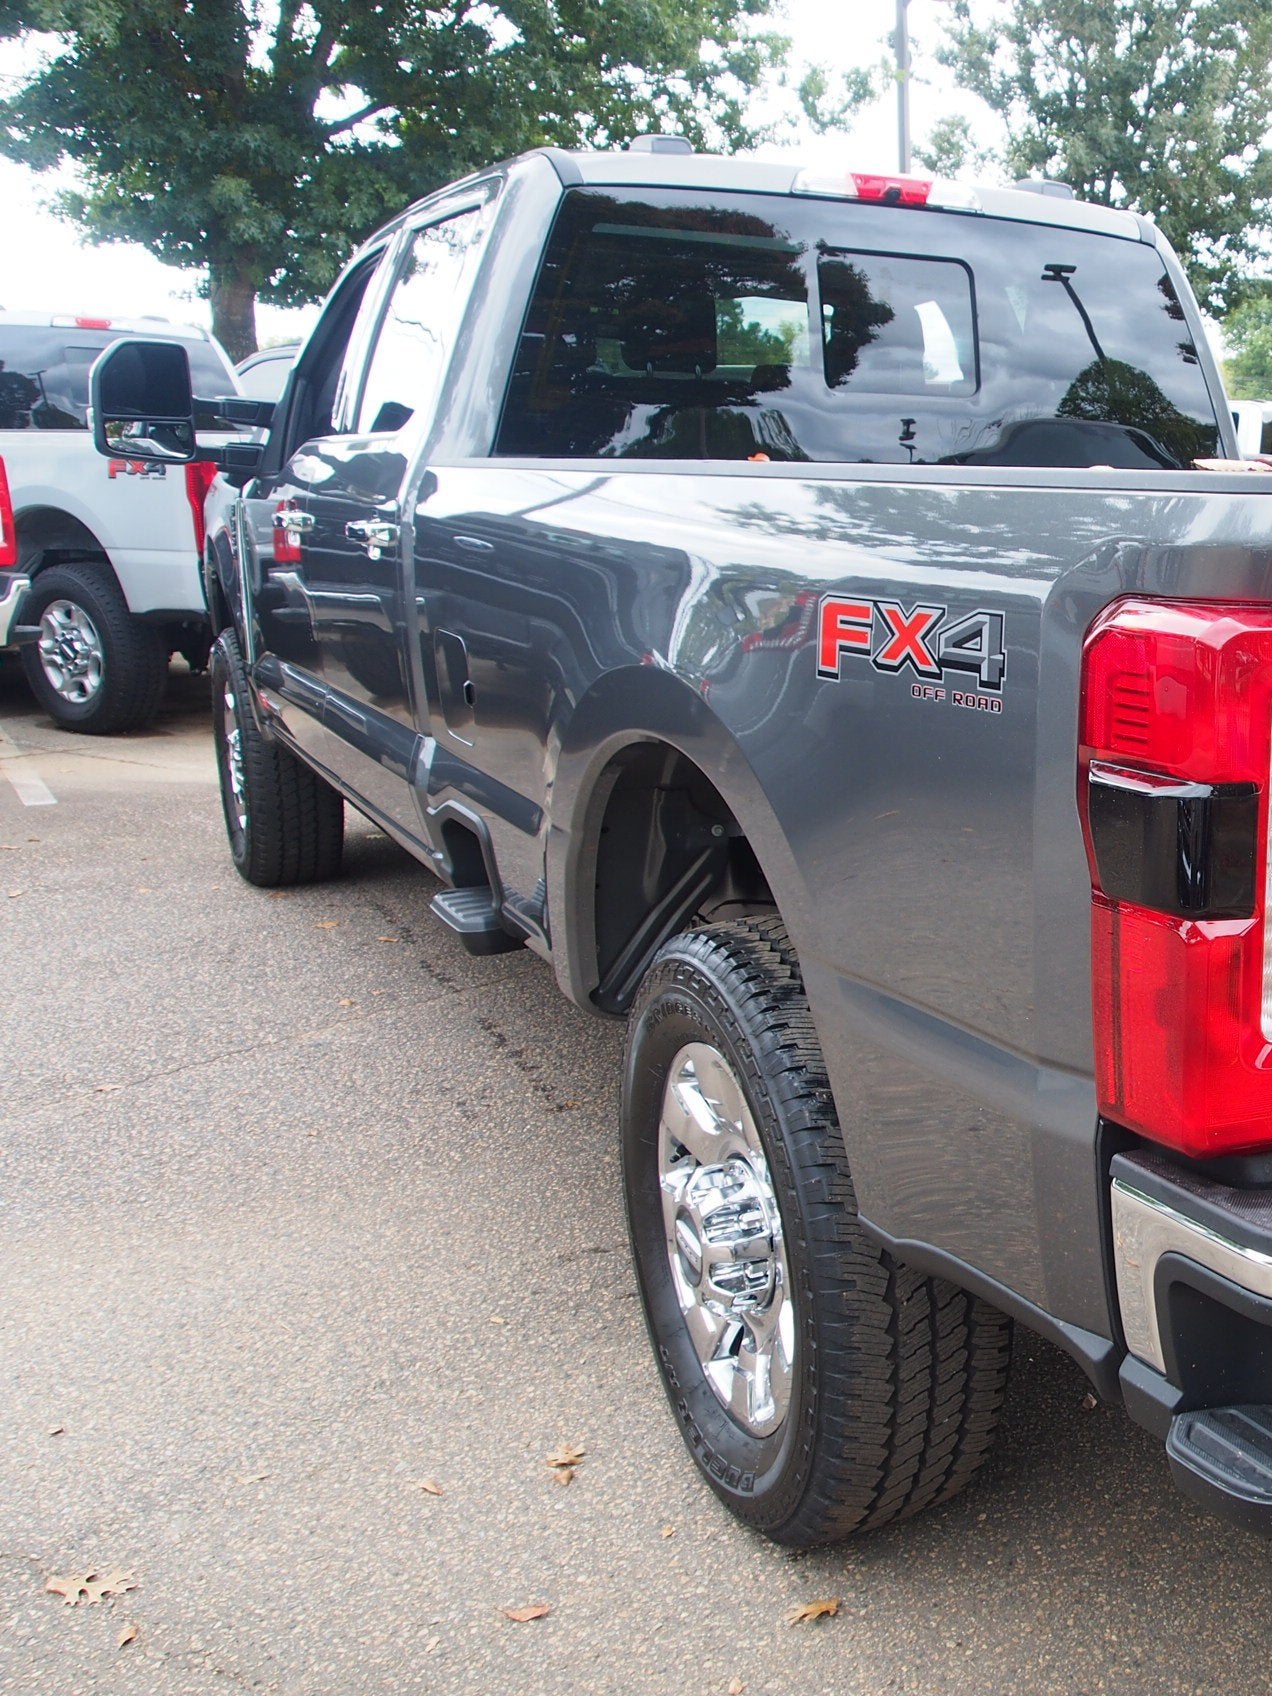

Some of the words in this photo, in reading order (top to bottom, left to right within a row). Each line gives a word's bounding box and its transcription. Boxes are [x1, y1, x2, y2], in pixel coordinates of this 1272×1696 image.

[816, 592, 1007, 694] FX4
[911, 683, 946, 702] OFF
[951, 691, 1003, 714] ROAD
